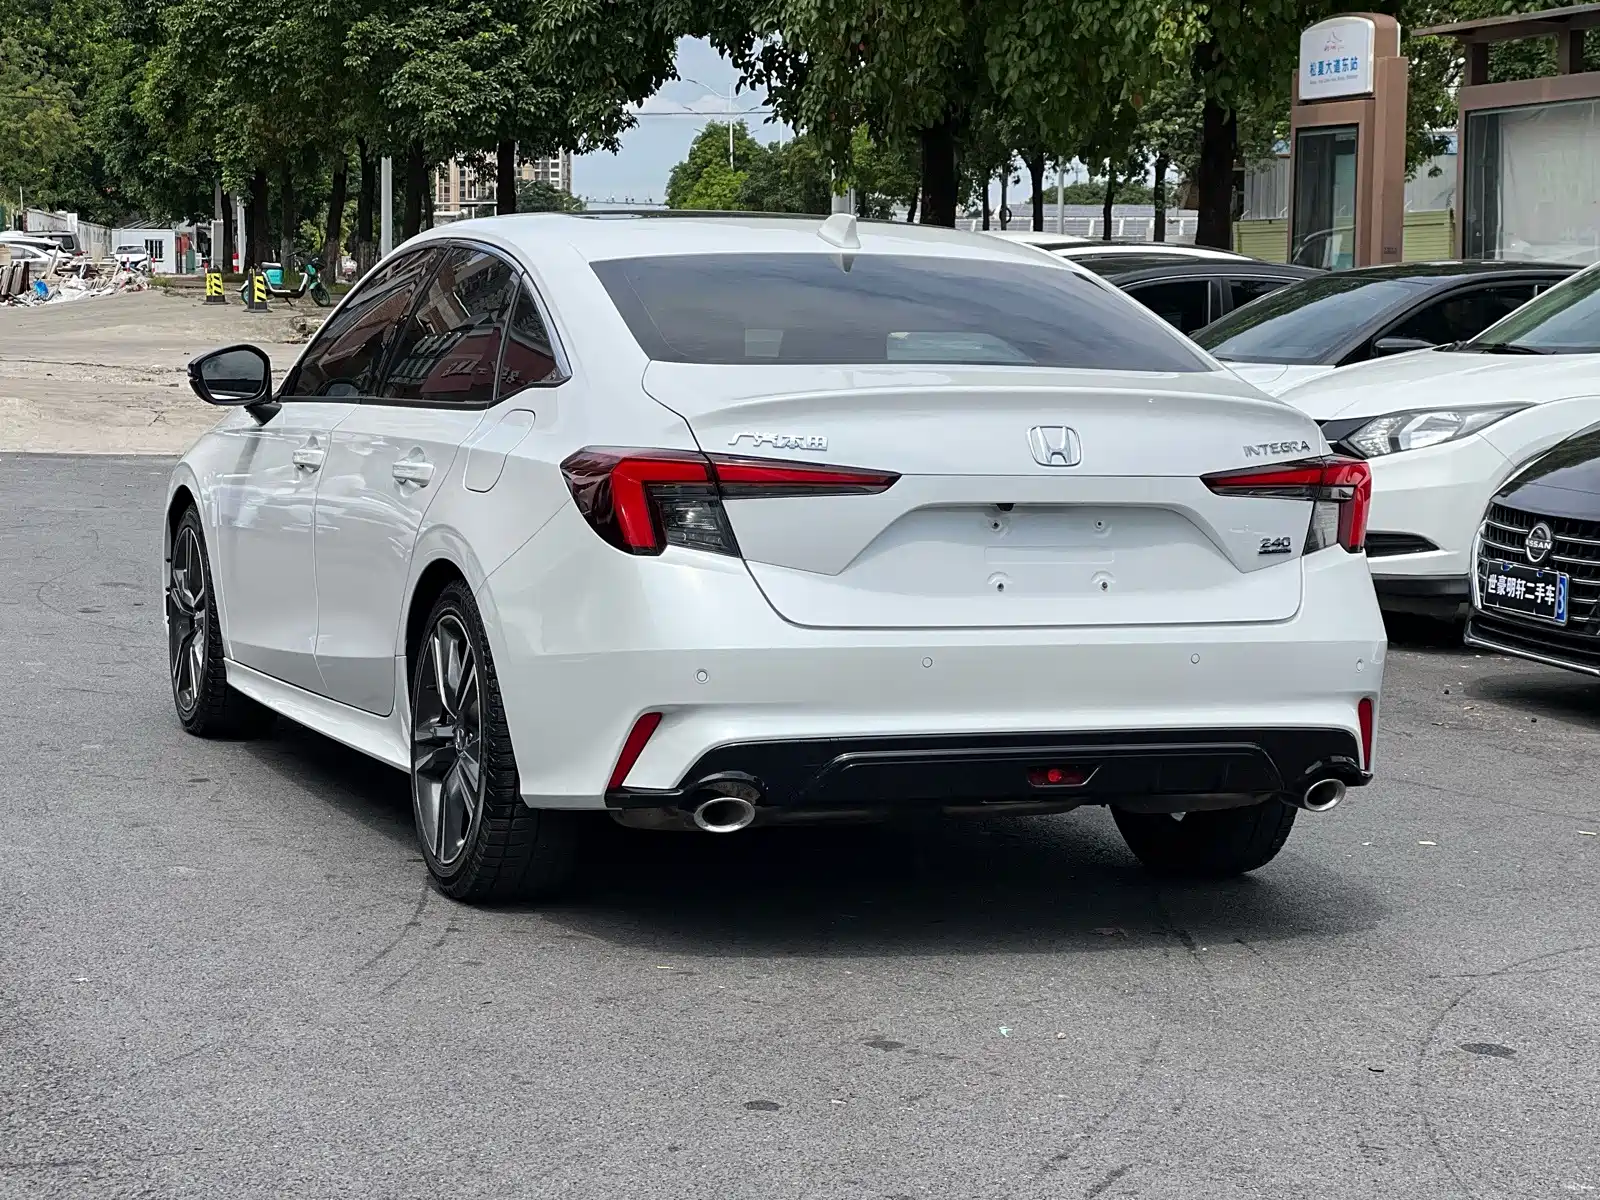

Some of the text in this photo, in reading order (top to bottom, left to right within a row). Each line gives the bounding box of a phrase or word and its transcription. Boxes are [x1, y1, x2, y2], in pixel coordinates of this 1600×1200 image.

[727, 432, 828, 451] 广汽本田
[1242, 440, 1311, 458] INTEGRA
[1260, 536, 1291, 548] 240
[1526, 538, 1552, 549] SSAN
[1487, 574, 1556, 606] 世豪明轩二手车
